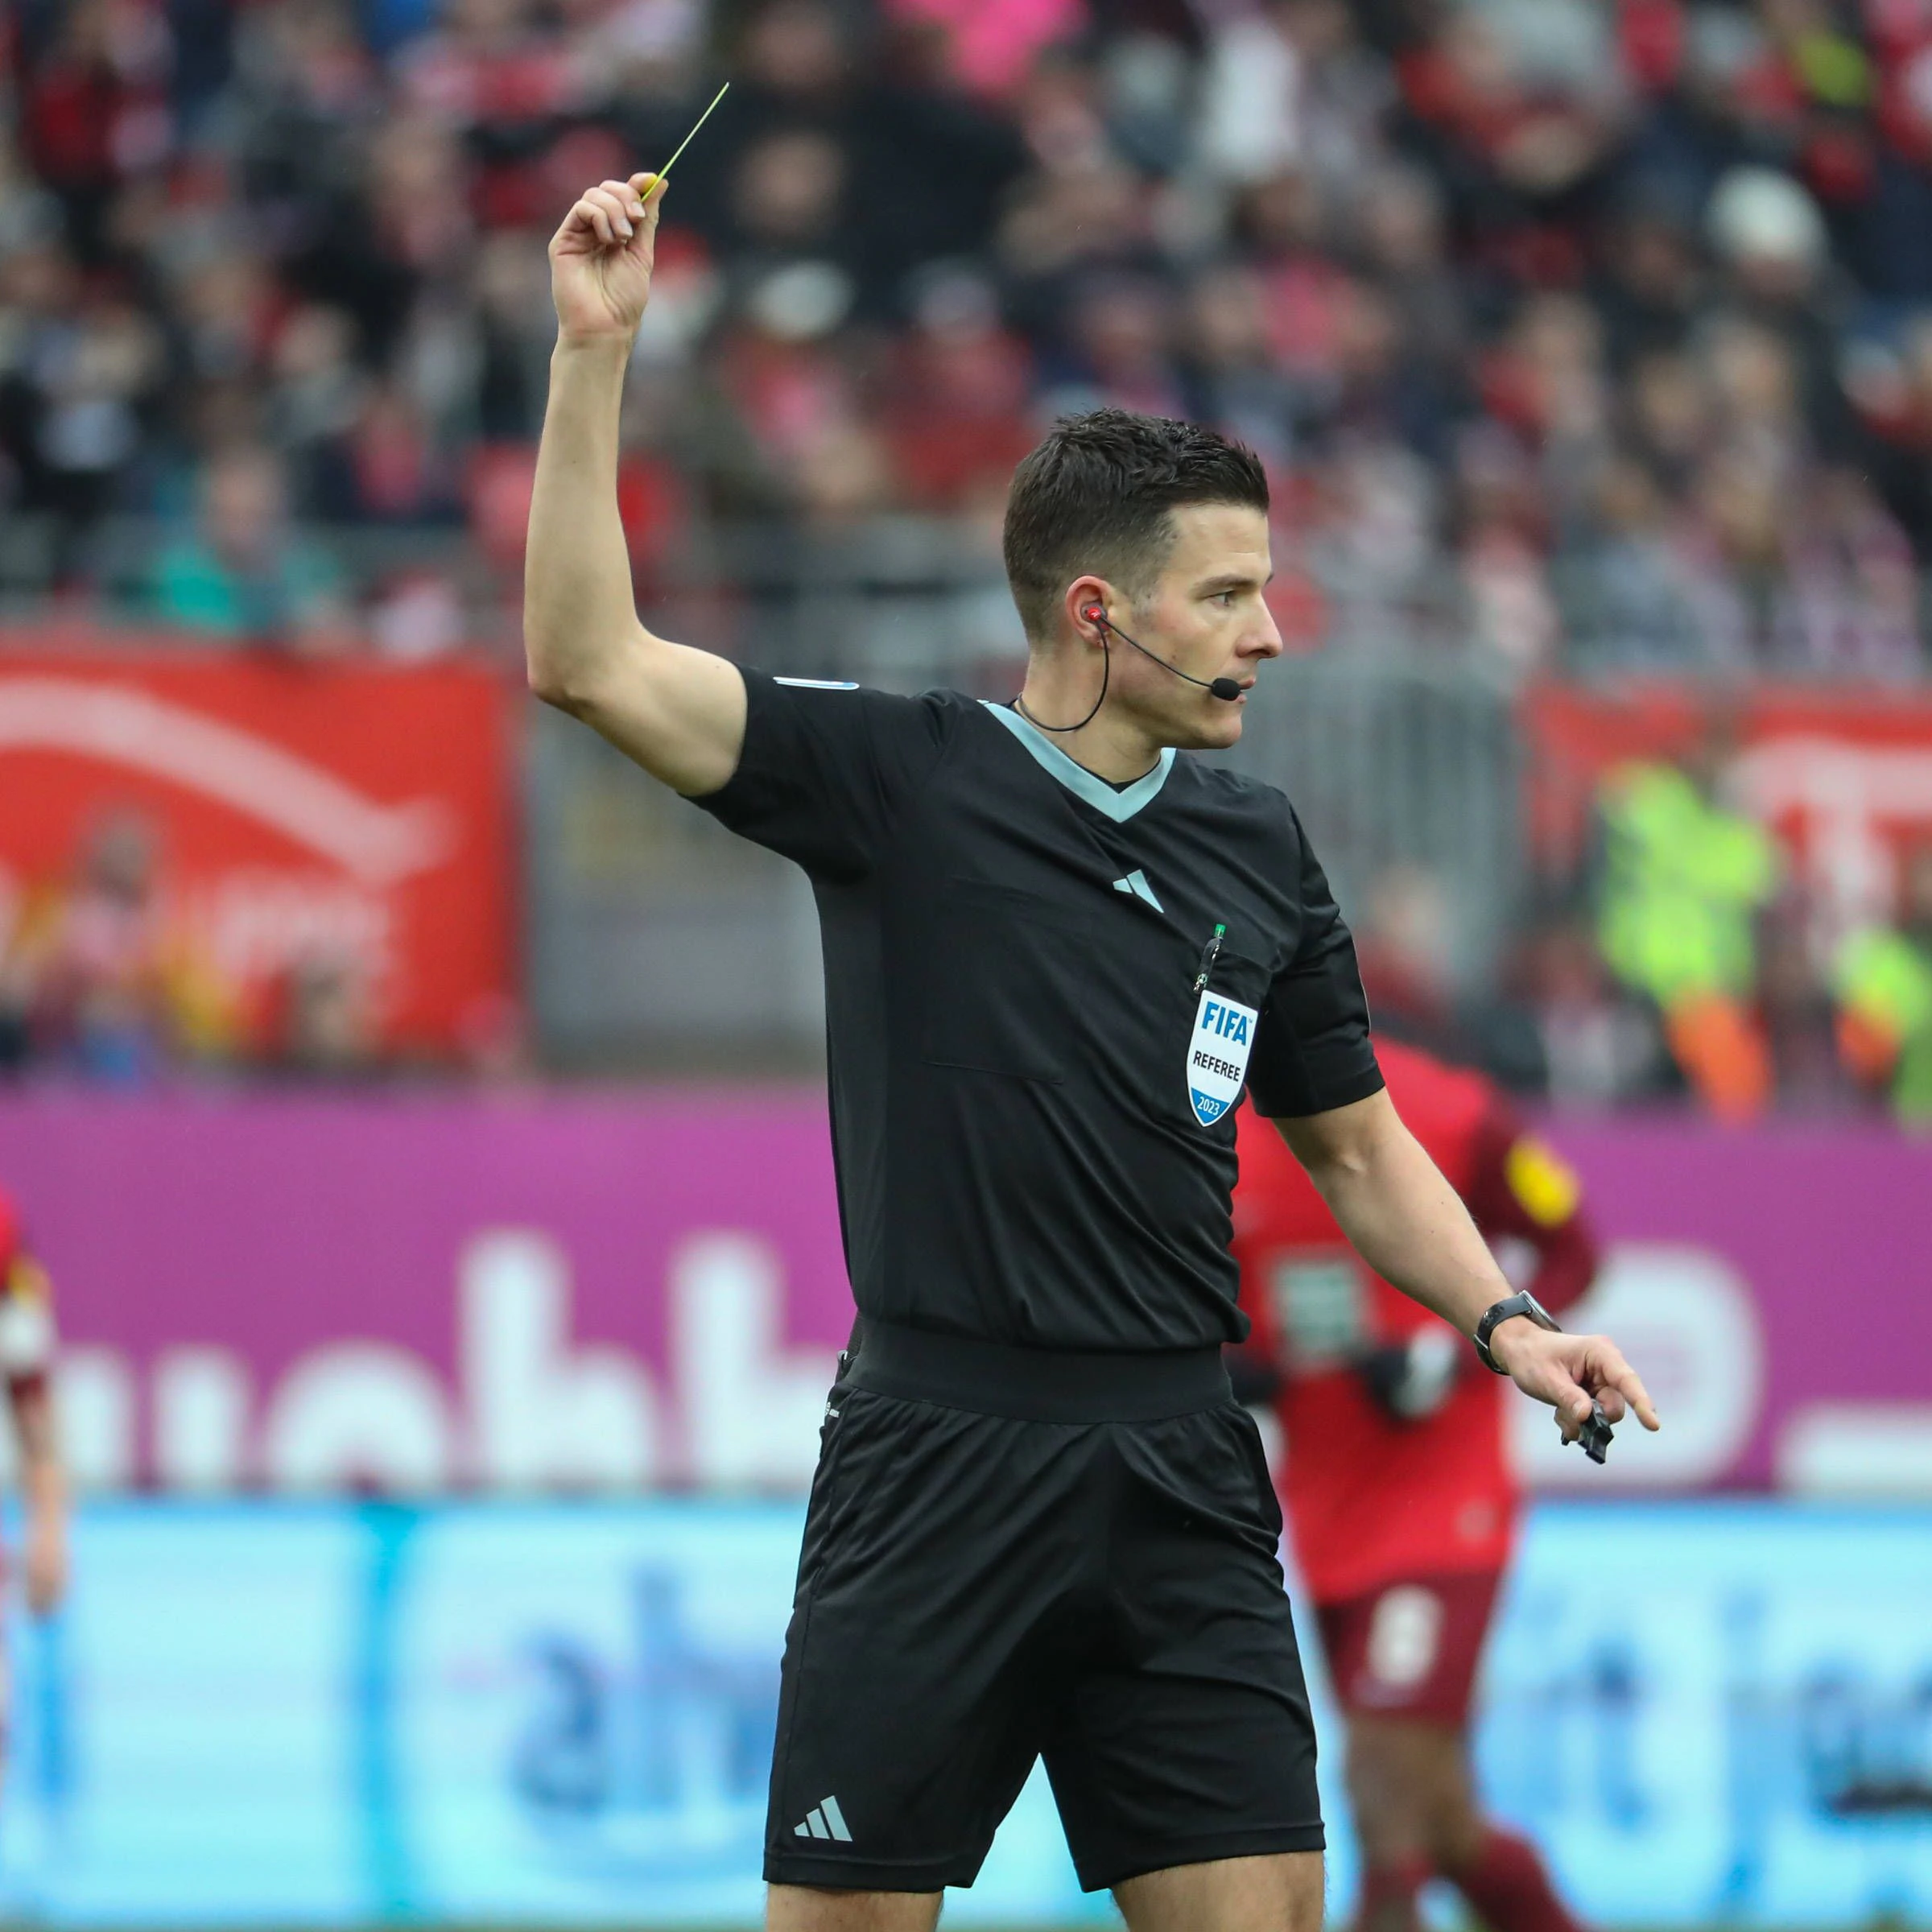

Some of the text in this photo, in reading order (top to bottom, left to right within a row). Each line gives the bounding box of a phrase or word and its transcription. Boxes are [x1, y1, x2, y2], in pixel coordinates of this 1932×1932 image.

[1202, 1001, 1247, 1046] FIFA
[1193, 1050, 1241, 1082] REFEREE
[1197, 1096, 1220, 1116] 2023
